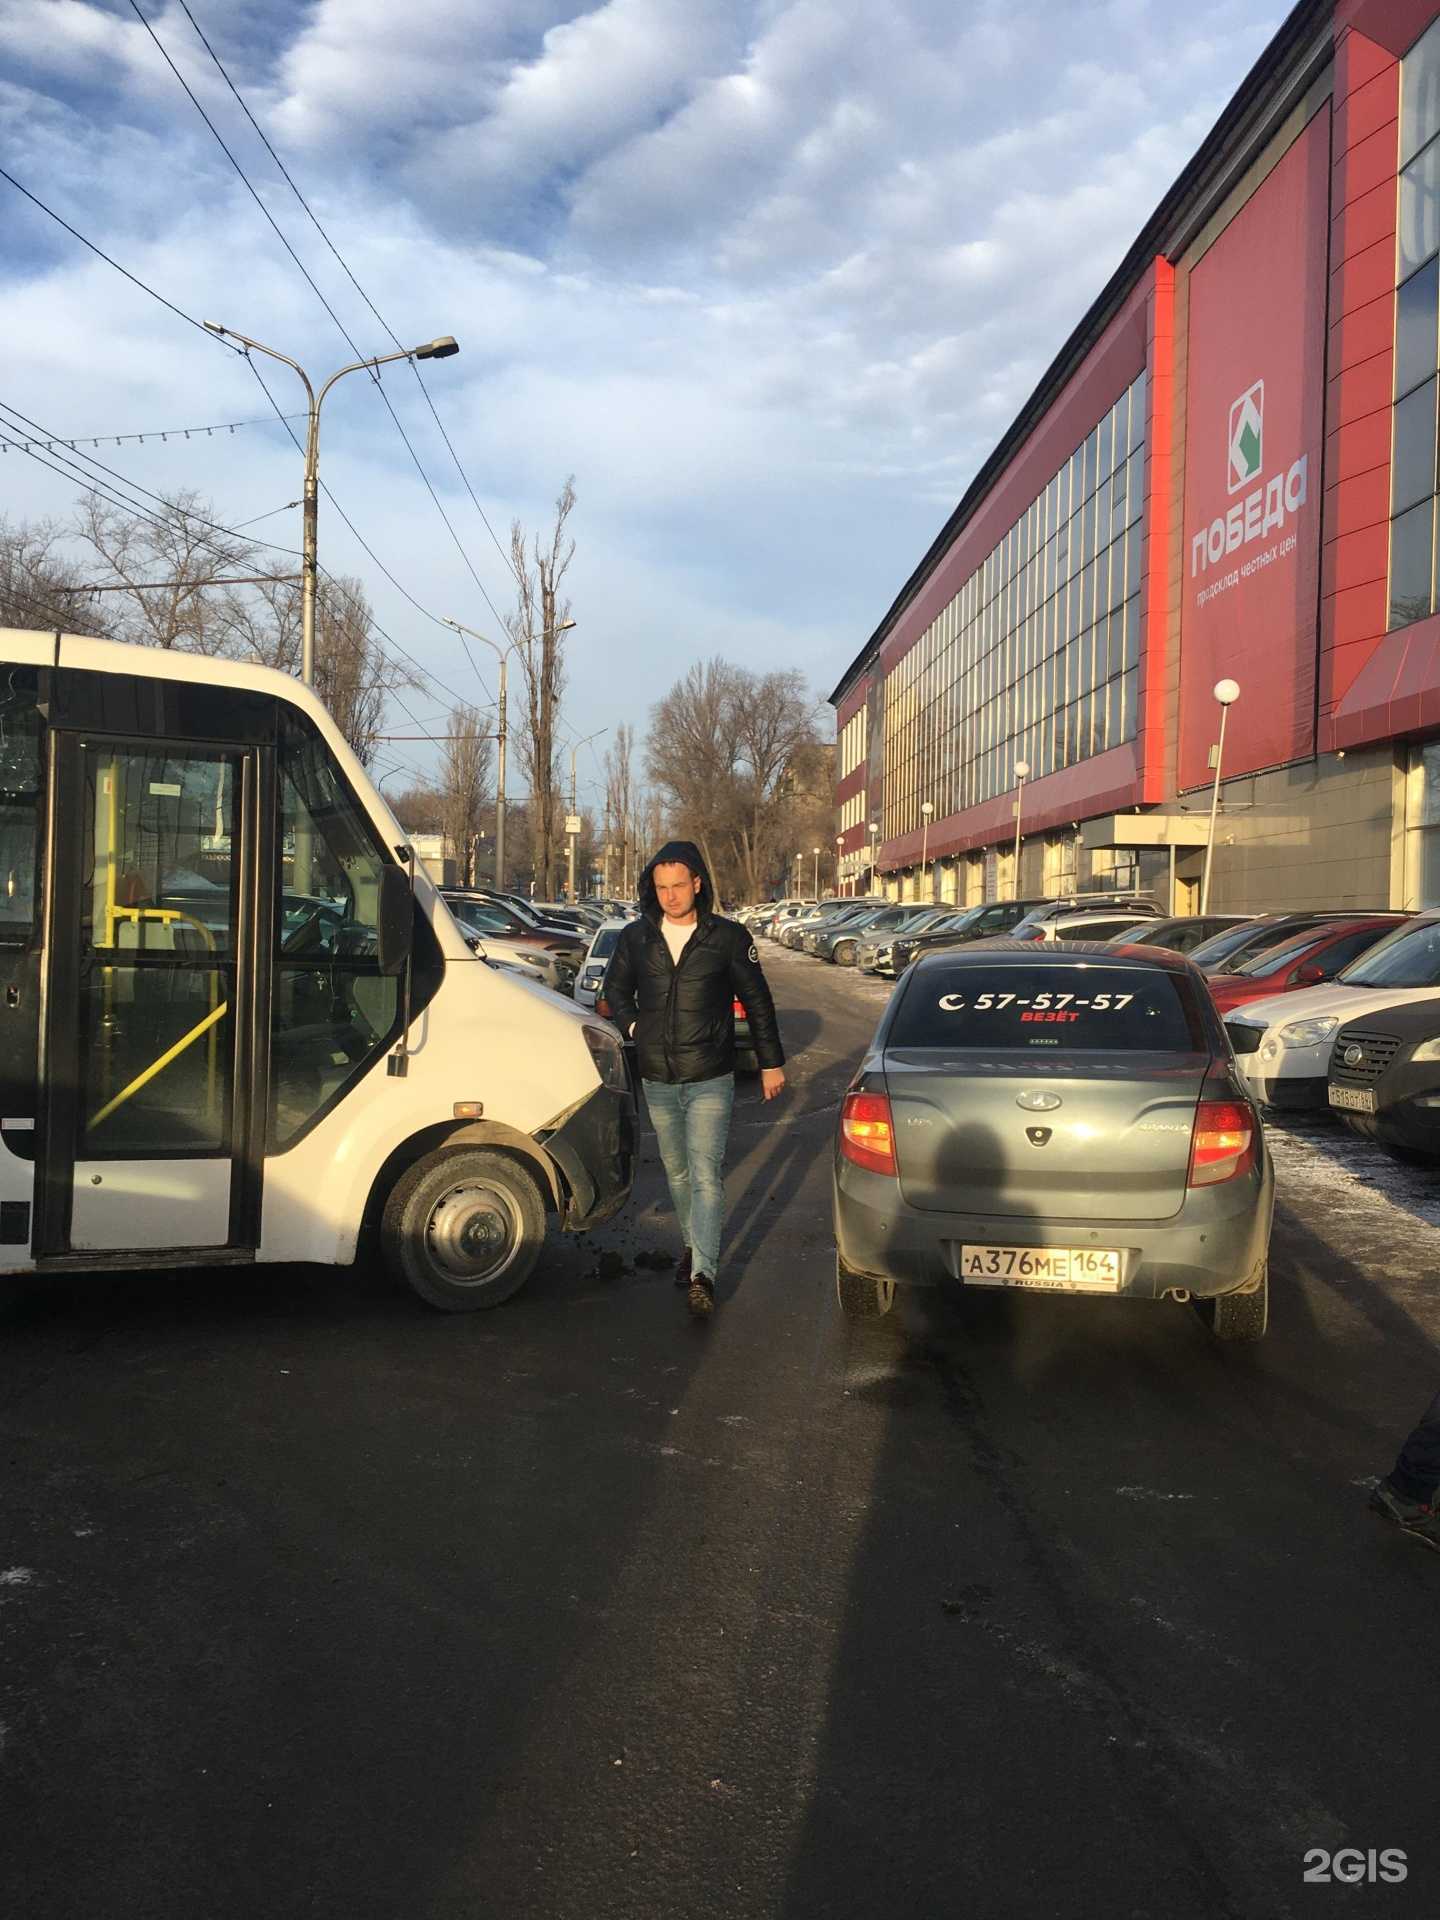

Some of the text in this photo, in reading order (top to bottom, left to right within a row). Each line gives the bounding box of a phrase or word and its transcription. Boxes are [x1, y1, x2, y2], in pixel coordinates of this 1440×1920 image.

[1241, 545, 1278, 577] честных
[1280, 533, 1297, 557] цен
[973, 993, 1134, 1010] 57-57-57
[1020, 1009, 1080, 1022] ВЕЗЁТ
[1074, 1252, 1114, 1272] 164
[1014, 1280, 1064, 1288] RUSSIA
